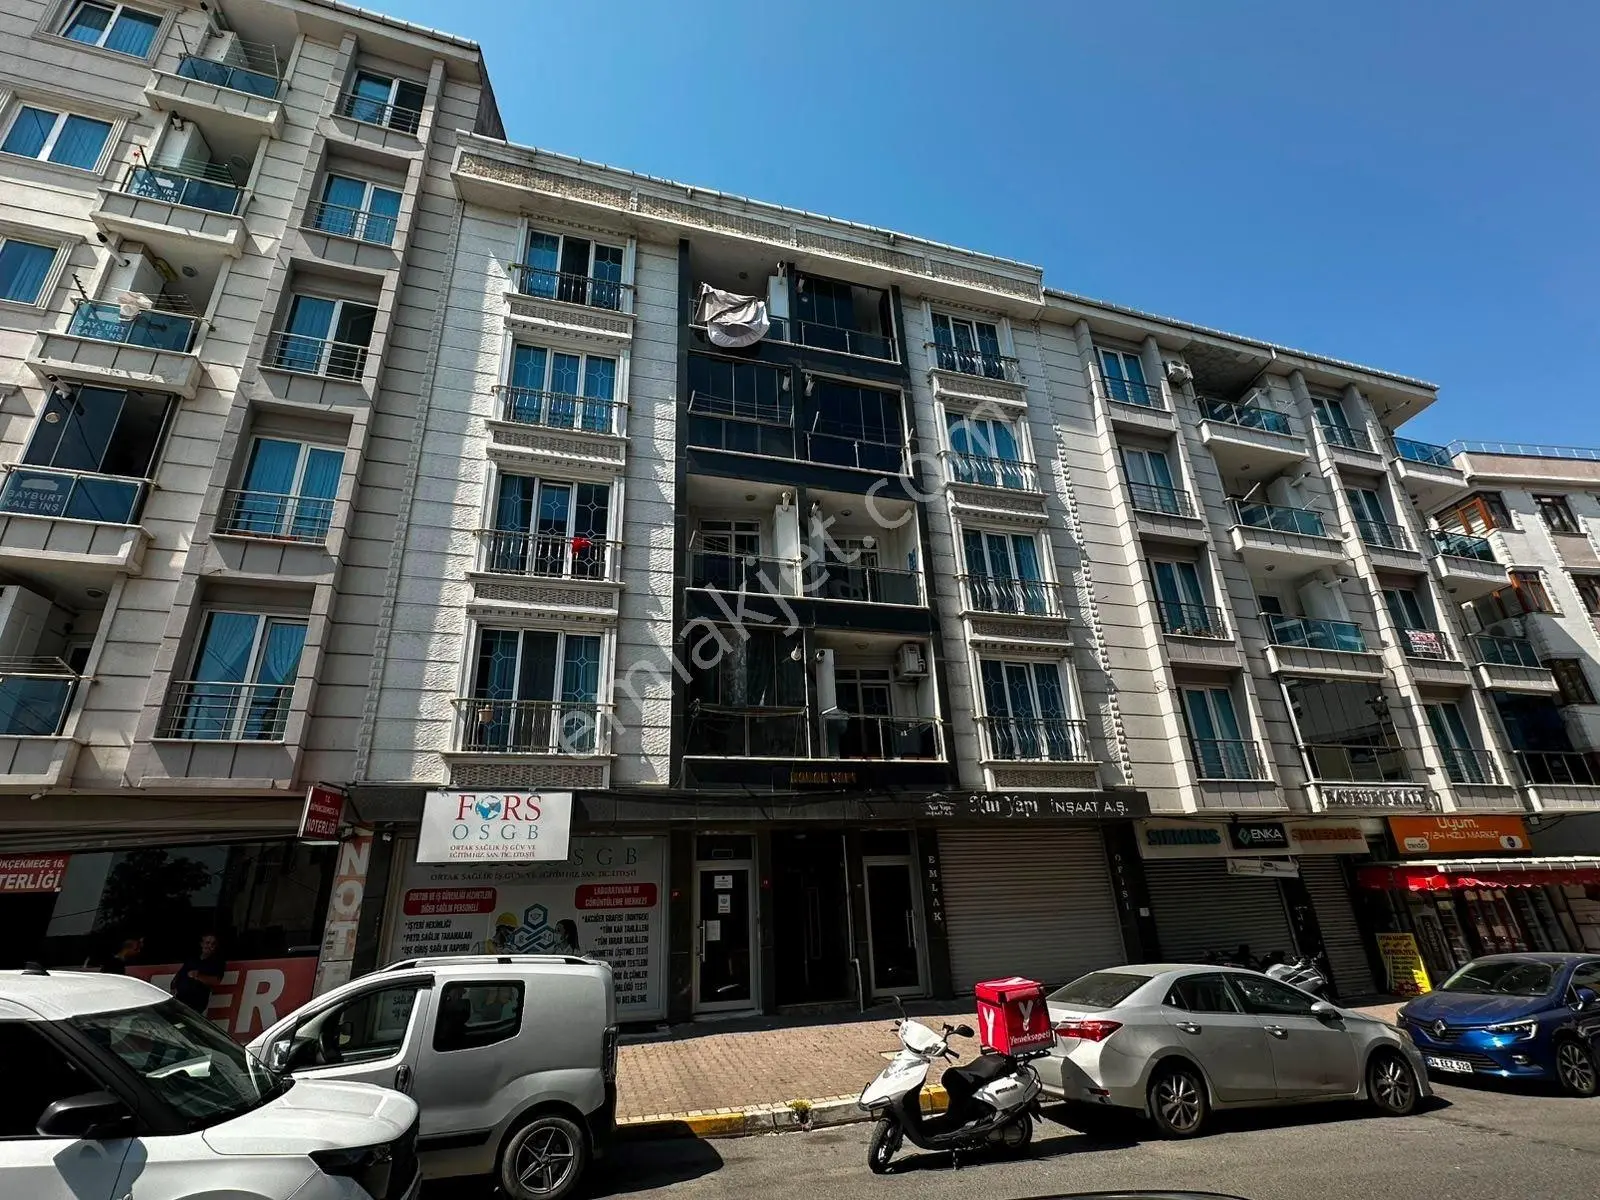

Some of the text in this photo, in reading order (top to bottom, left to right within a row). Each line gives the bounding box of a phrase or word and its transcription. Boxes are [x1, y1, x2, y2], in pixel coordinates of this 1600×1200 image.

[7, 489, 63, 502] BAYBURT
[2, 499, 36, 510] KALE
[1050, 798, 1099, 816] İNŞAAT
[1250, 828, 1283, 839] ENKA
[1467, 831, 1501, 839] MARKET
[475, 843, 500, 852] SAĞLIK
[927, 855, 943, 921] EMLAK
